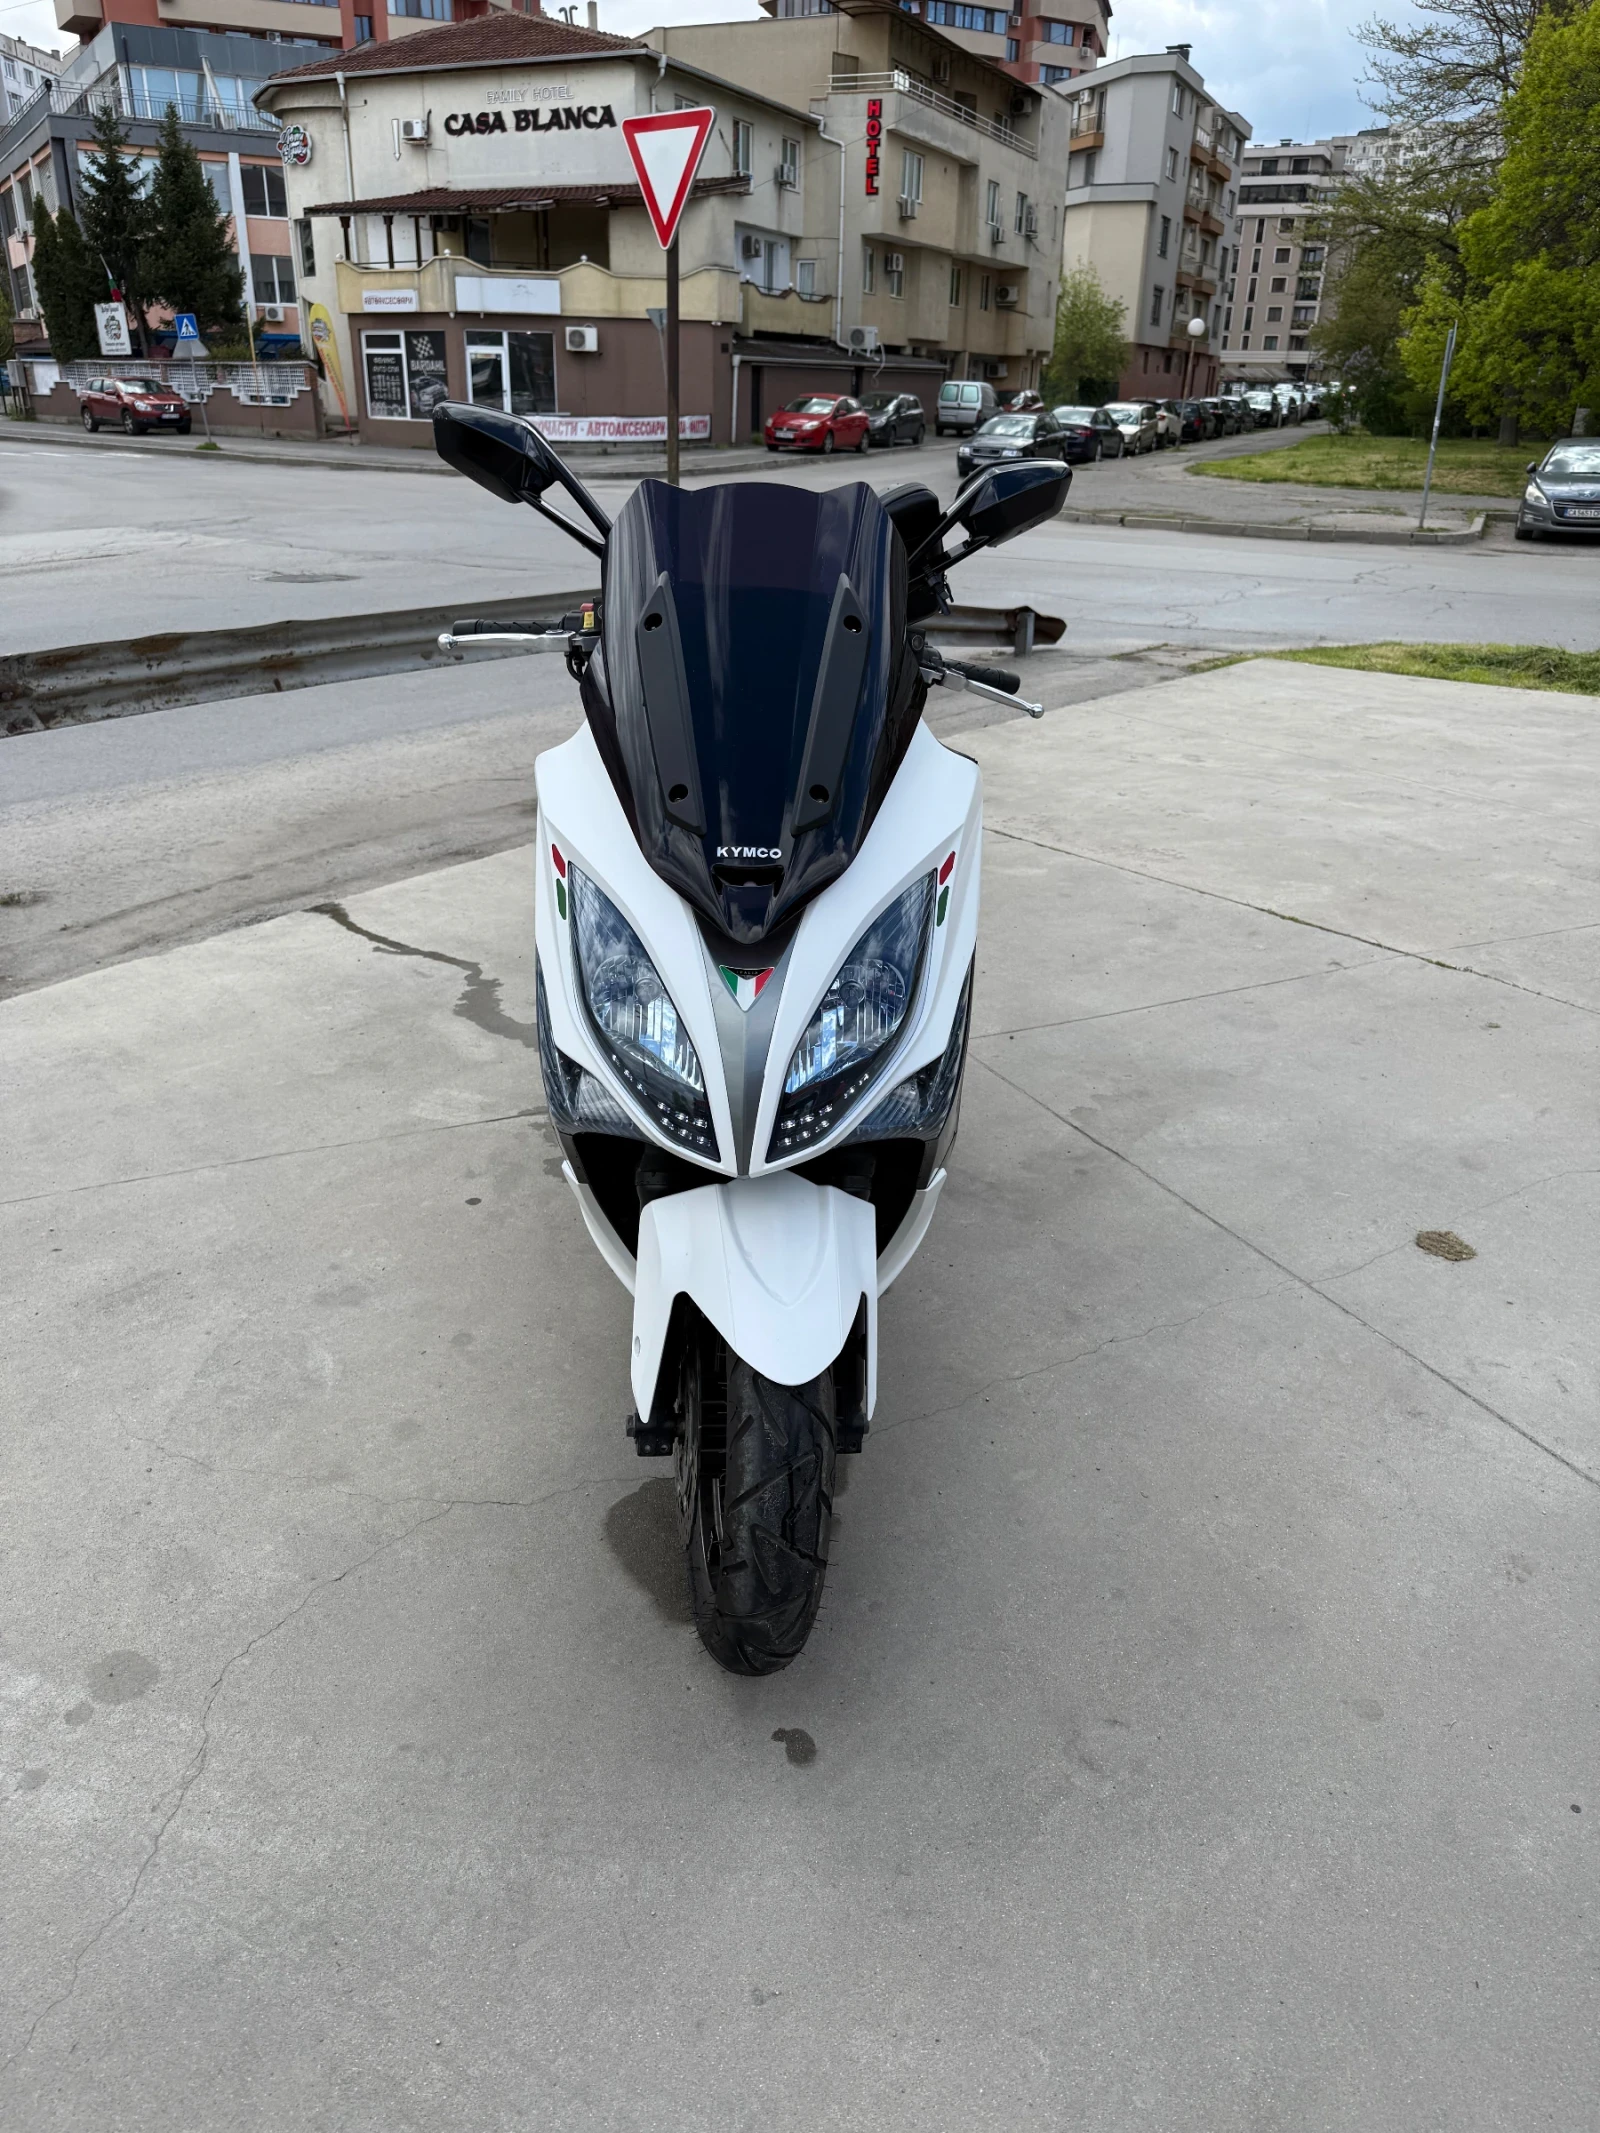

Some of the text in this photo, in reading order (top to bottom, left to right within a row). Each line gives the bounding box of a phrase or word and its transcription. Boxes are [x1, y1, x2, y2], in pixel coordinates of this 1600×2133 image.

[486, 85, 574, 104] FAMILY HOTEL
[444, 104, 617, 137] CASA BLANCA
[865, 99, 882, 195] HOTEL
[410, 360, 446, 371] BARDAHL
[533, 420, 578, 437] ОЧАСТИ
[587, 420, 666, 436] АВТОАКСЕСОАРИ
[717, 846, 782, 859] KYMCO
